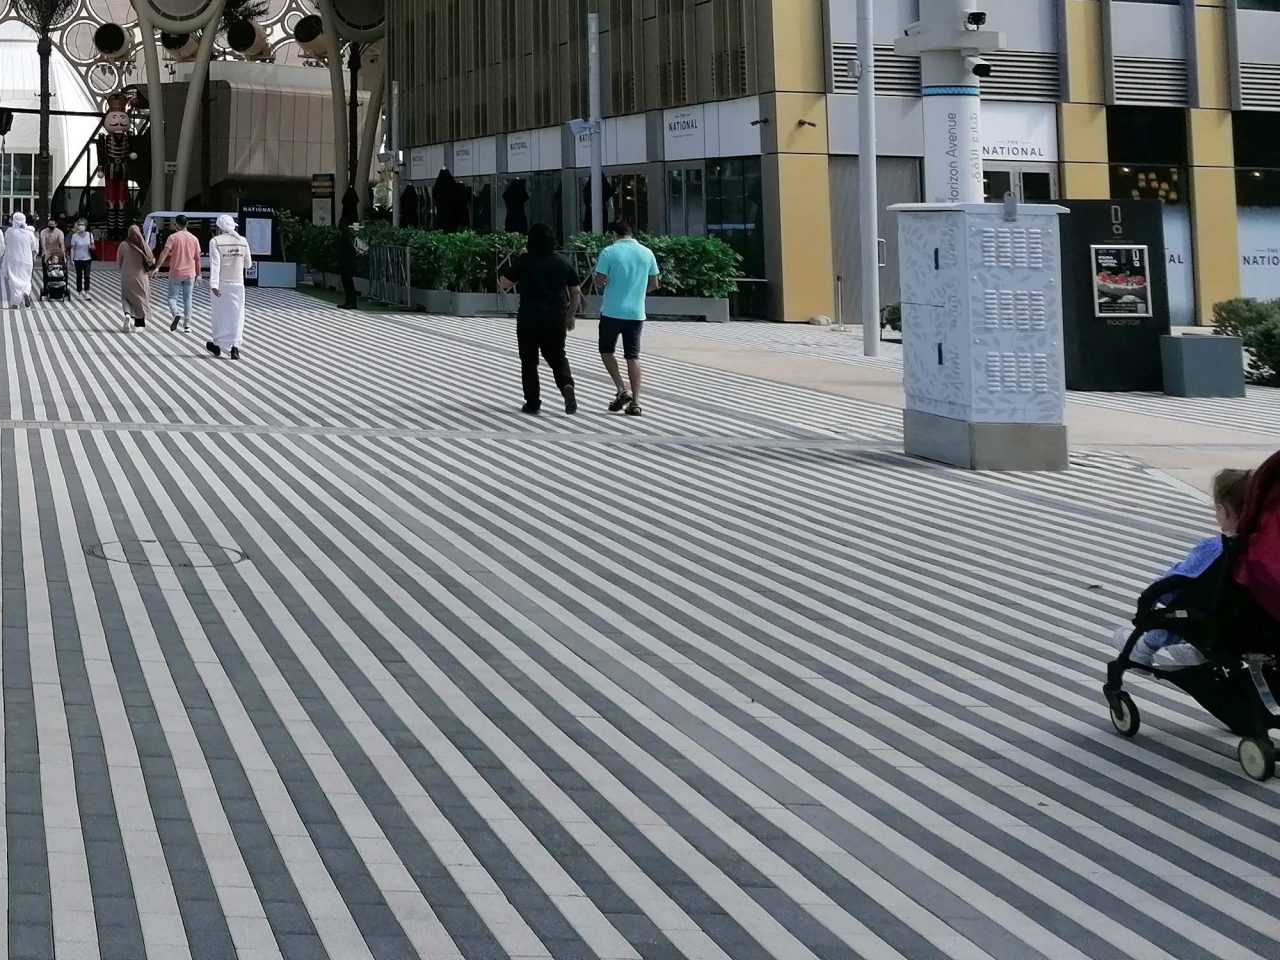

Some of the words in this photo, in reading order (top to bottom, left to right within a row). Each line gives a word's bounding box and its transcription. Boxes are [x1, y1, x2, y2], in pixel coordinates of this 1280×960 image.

[668, 120, 698, 132] NATIONAL
[970, 112, 979, 143] شارع
[946, 112, 958, 158] Avenue
[510, 141, 528, 151] NATIONAL
[982, 146, 1044, 157] NATIONAL
